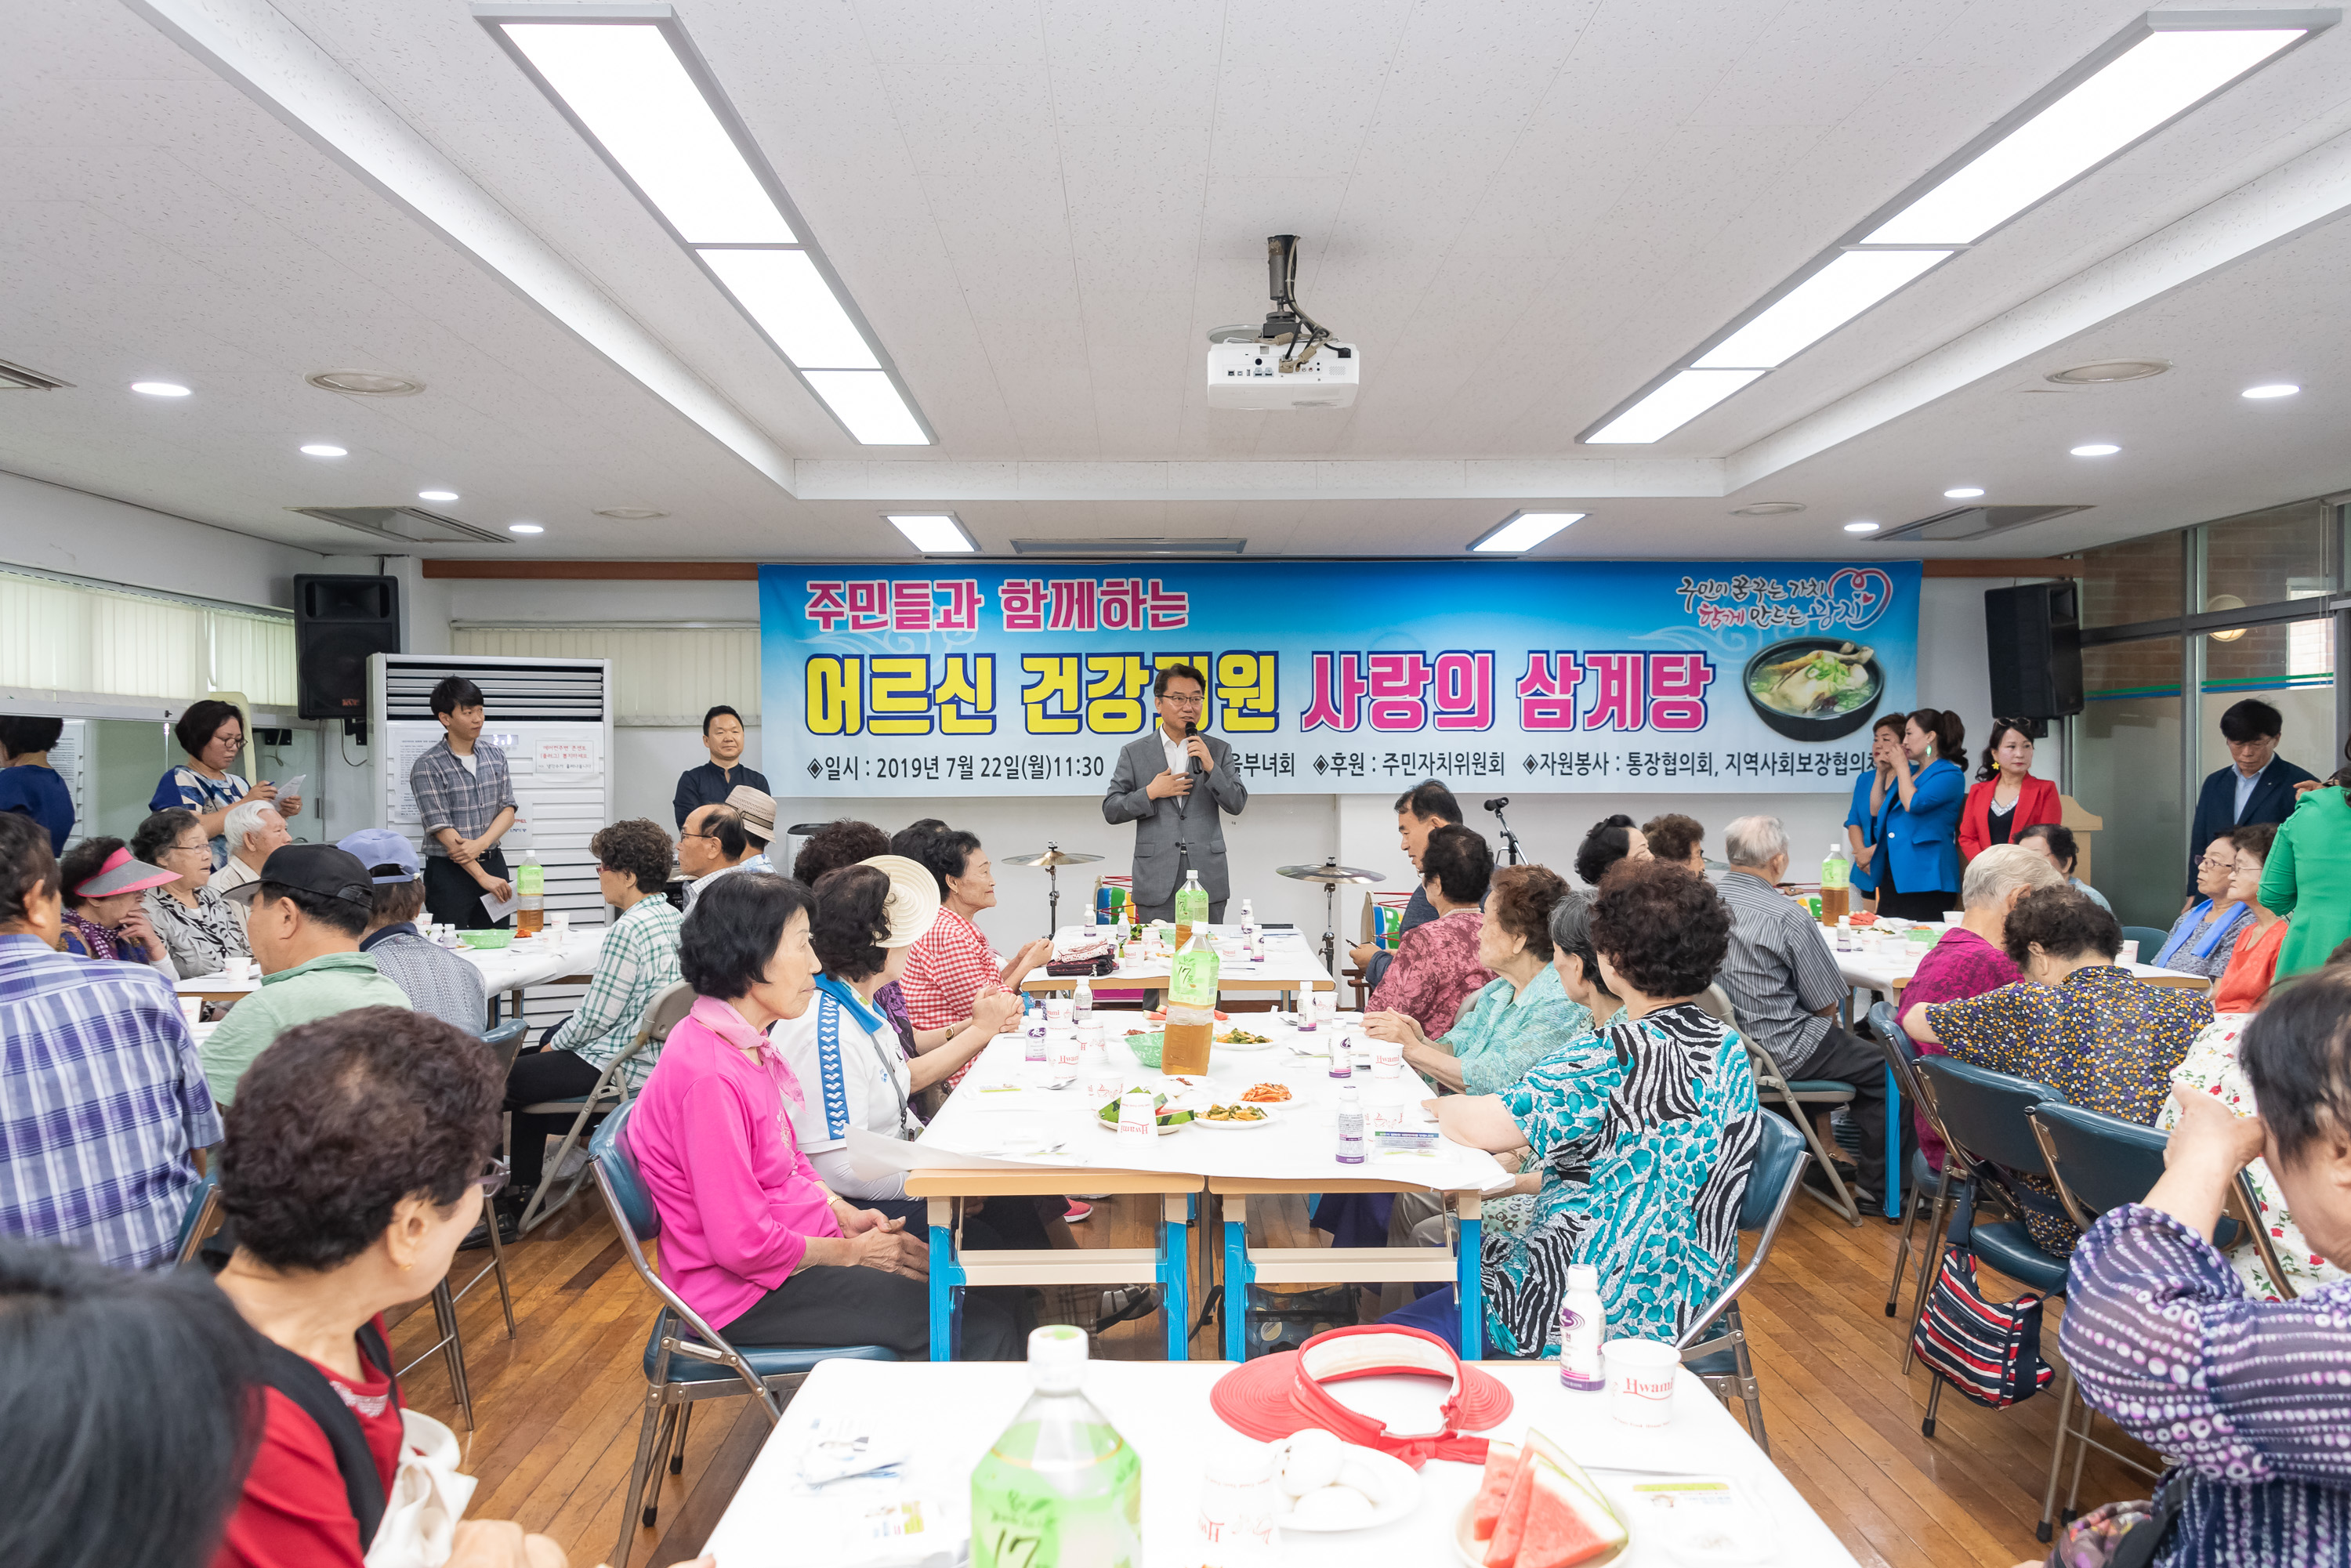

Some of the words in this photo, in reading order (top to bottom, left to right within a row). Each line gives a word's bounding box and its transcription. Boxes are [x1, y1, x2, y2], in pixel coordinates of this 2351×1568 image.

[805, 579, 985, 632] 주민들과
[998, 578, 1189, 632] 함께하는
[1676, 576, 1730, 613] 구민이
[1730, 574, 1787, 604] 꿈꾸는
[1788, 578, 1827, 598] 가치
[1697, 603, 1746, 629] 함께
[1748, 603, 1806, 629] 만드는
[1807, 597, 1864, 630] 광진
[805, 653, 997, 736] 어르신
[1300, 650, 1495, 733] 사랑의
[1515, 650, 1716, 733] 삼계탕
[825, 755, 858, 780] 일시
[877, 755, 939, 779] 2019년
[946, 755, 973, 780] 7월
[980, 754, 1104, 780] 22일(월)11:30
[1331, 752, 1364, 777] 후원
[1382, 751, 1505, 777] 주민자치위원회
[1540, 751, 1609, 777] 자원봉사
[1627, 751, 1719, 777] 통장협의회,
[1376, 1055, 1400, 1064] Hwami
[1121, 1124, 1148, 1135] Hwami
[1626, 1377, 1673, 1395] Hwami
